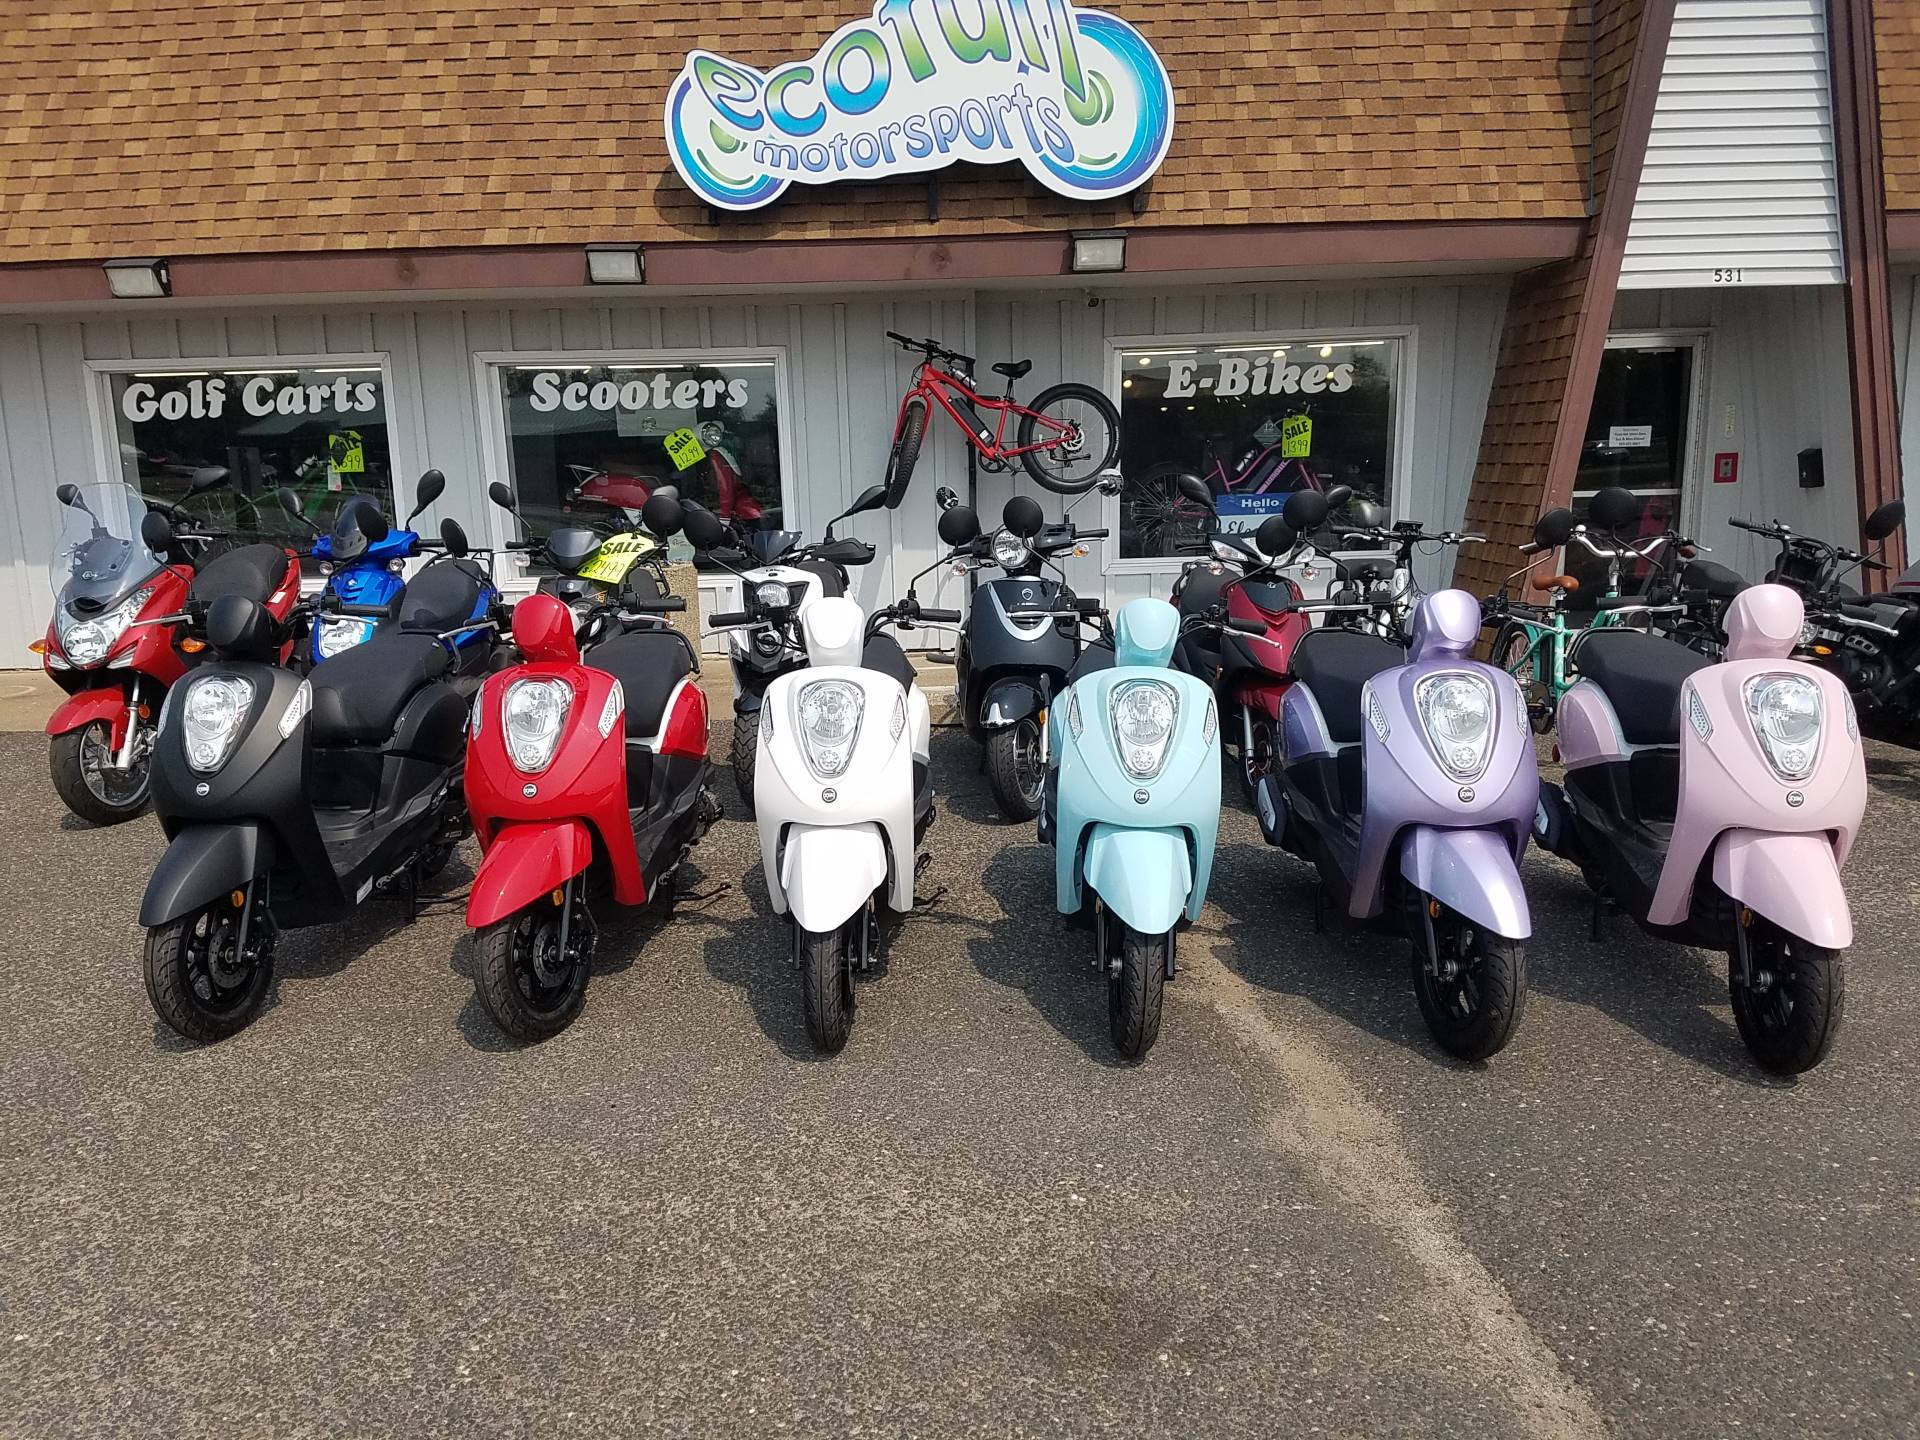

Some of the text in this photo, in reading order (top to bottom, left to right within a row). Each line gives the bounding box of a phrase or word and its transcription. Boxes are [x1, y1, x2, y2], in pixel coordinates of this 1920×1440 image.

[753, 83, 1075, 173] motorsports
[1714, 269, 1742, 282] 531
[1163, 356, 1354, 398] E-Bikes
[122, 376, 376, 422] Golf Carts
[530, 372, 748, 411] Scooters
[1284, 421, 1309, 440] SALE
[669, 432, 693, 454] SALE
[1241, 498, 1280, 508] Hello
[600, 542, 645, 556] SALE
